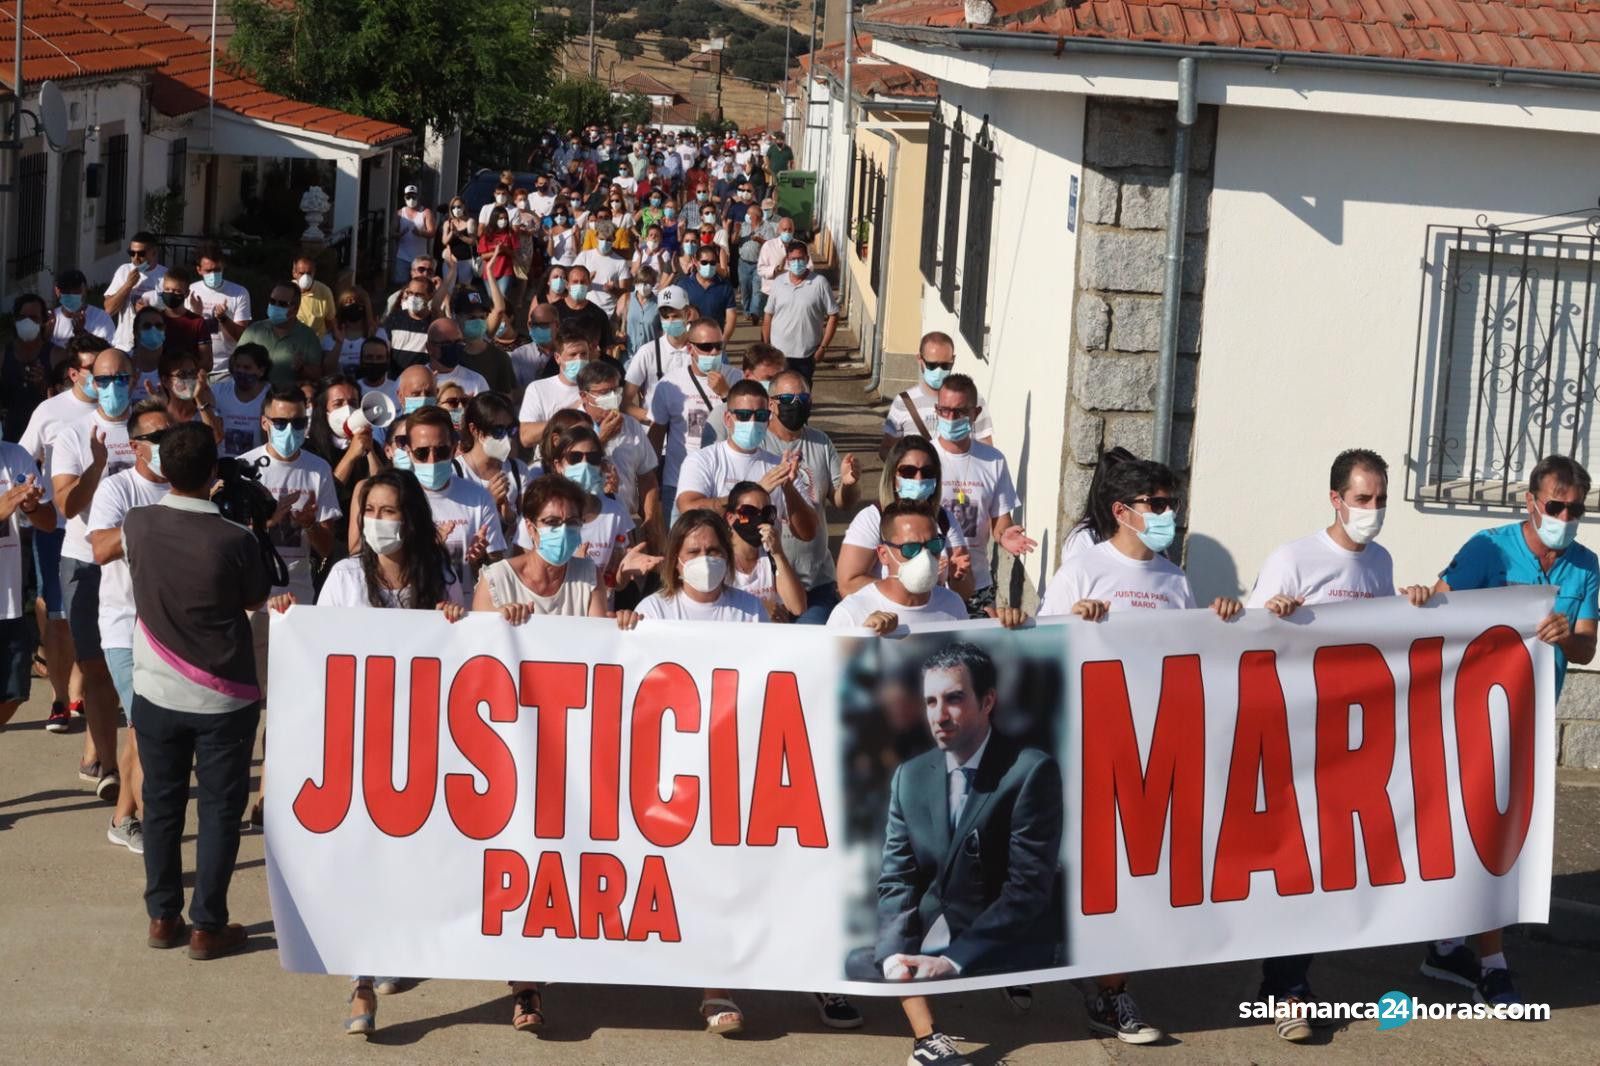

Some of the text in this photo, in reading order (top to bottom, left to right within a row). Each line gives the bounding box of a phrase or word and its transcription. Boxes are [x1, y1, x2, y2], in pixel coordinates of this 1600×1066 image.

[1113, 591, 1169, 602] JUSTICIA PARA
[1131, 600, 1156, 609] MARIO
[292, 625, 1535, 916] JUSTICIA MARIO
[481, 848, 682, 943] PARA
